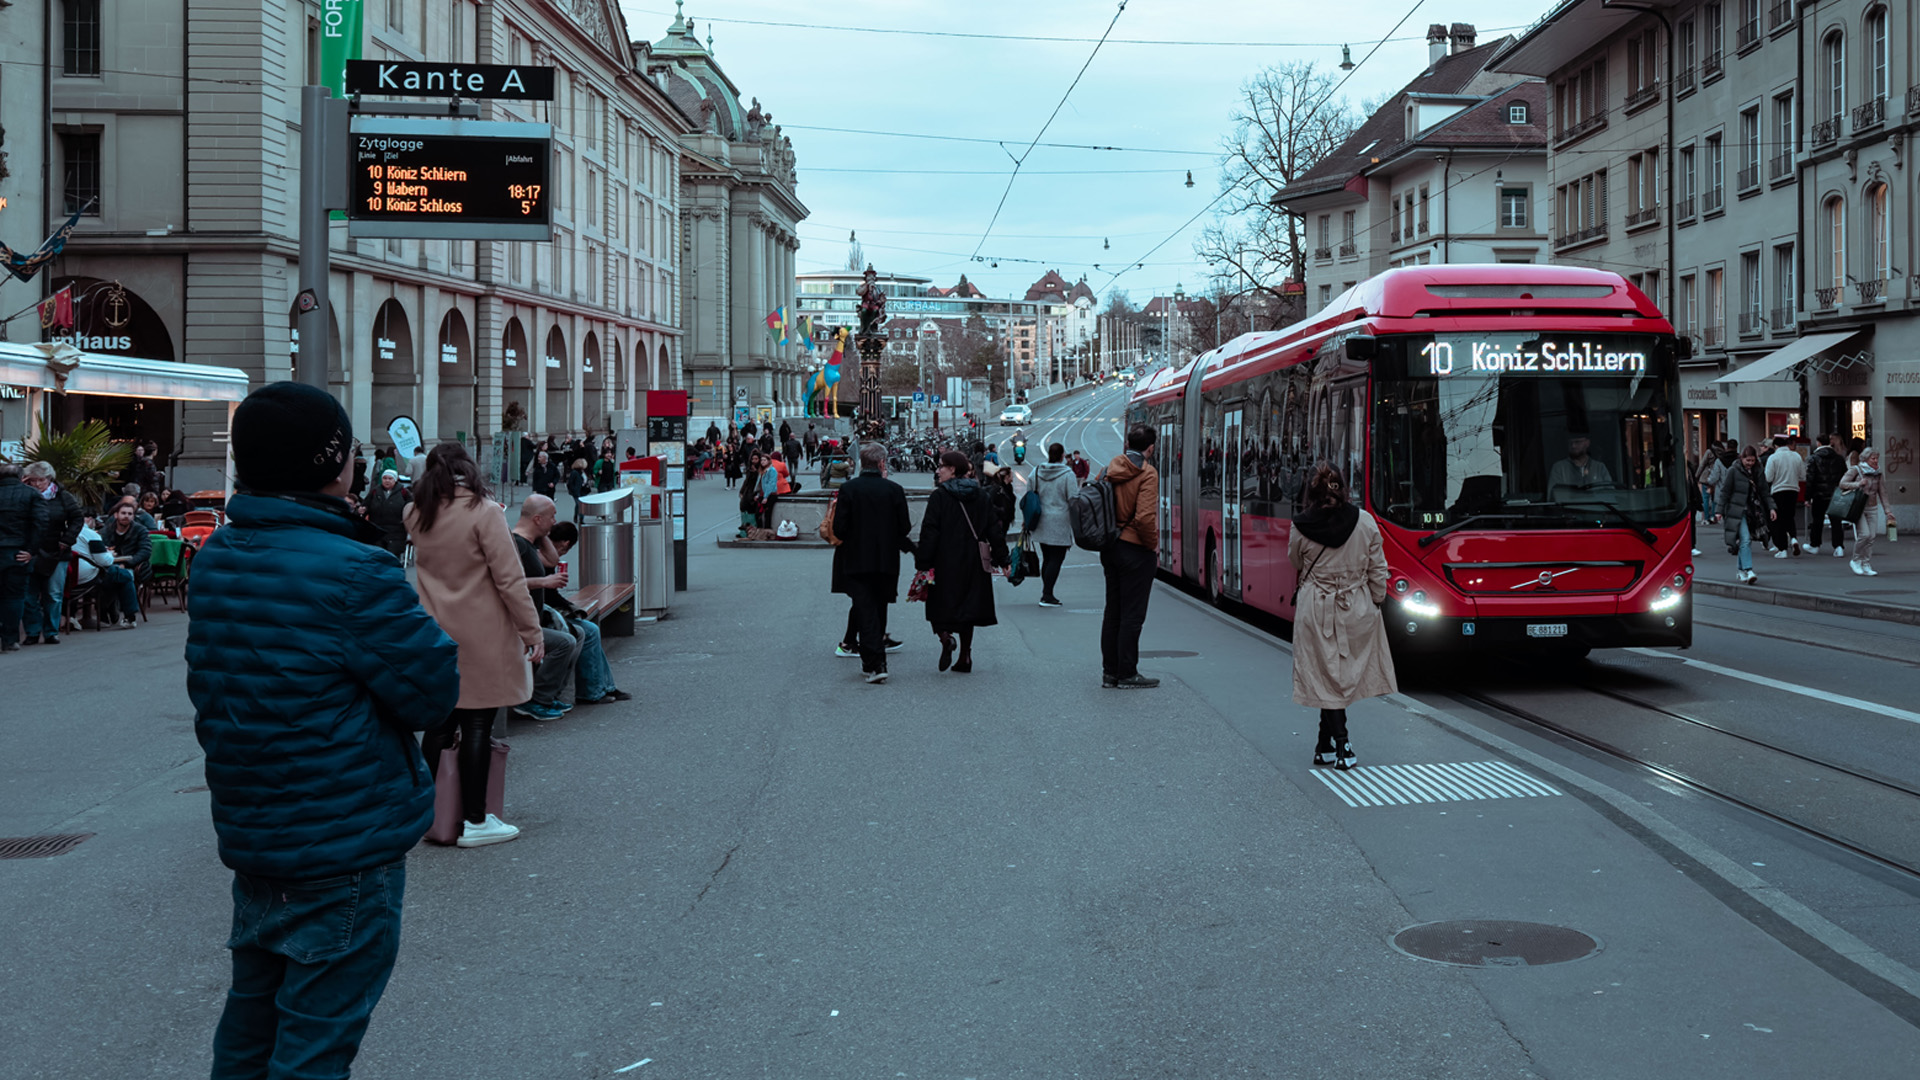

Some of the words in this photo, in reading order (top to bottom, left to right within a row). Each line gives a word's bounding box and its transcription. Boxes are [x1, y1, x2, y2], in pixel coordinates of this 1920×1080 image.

[378, 64, 484, 92] Kante
[501, 69, 526, 93] A
[358, 137, 424, 152] Zytglogge
[360, 152, 376, 160] Linie
[386, 152, 399, 160] Ziel
[509, 155, 533, 164] Abfahrt
[367, 165, 383, 179] 10
[387, 165, 417, 180] Köniz
[420, 166, 467, 181] Schliern
[373, 181, 382, 195] 9
[386, 181, 428, 196] Wabern
[508, 185, 541, 199] 18:17
[366, 197, 382, 211] 10
[386, 197, 417, 212] Köniz
[419, 198, 463, 213] Schloss
[1421, 342, 1453, 375] 10
[1472, 342, 1539, 371] Köniz
[1541, 342, 1645, 371] Schliern
[313, 426, 344, 466] GANT
[1422, 512, 1432, 523] 10
[1434, 512, 1444, 523] 10
